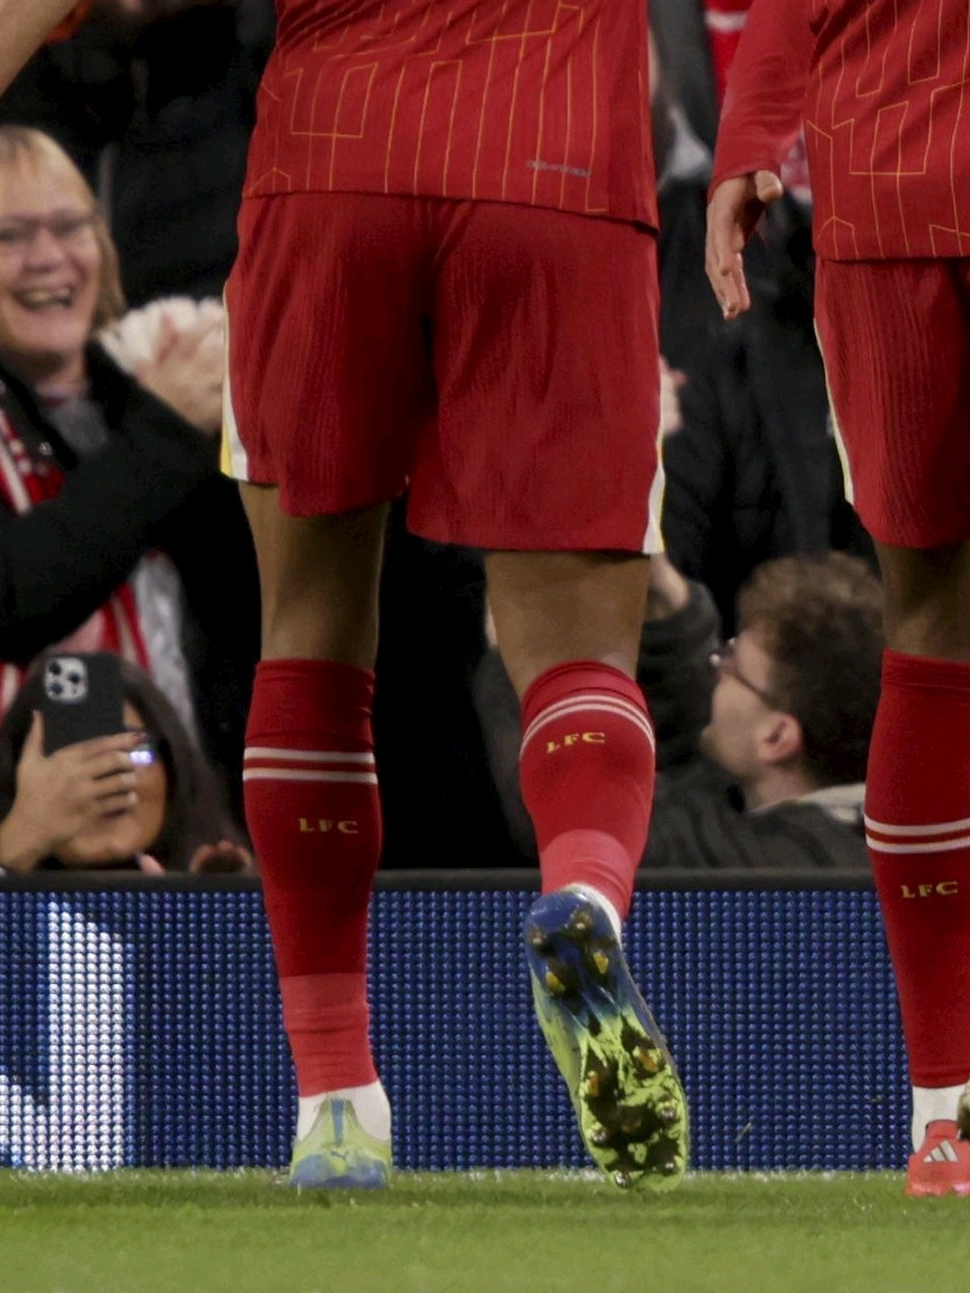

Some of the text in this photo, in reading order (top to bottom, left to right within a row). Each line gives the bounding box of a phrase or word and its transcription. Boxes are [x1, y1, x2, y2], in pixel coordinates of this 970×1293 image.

[546, 731, 606, 753] LFC
[299, 817, 359, 834] LFC
[900, 881, 959, 898] LFC
